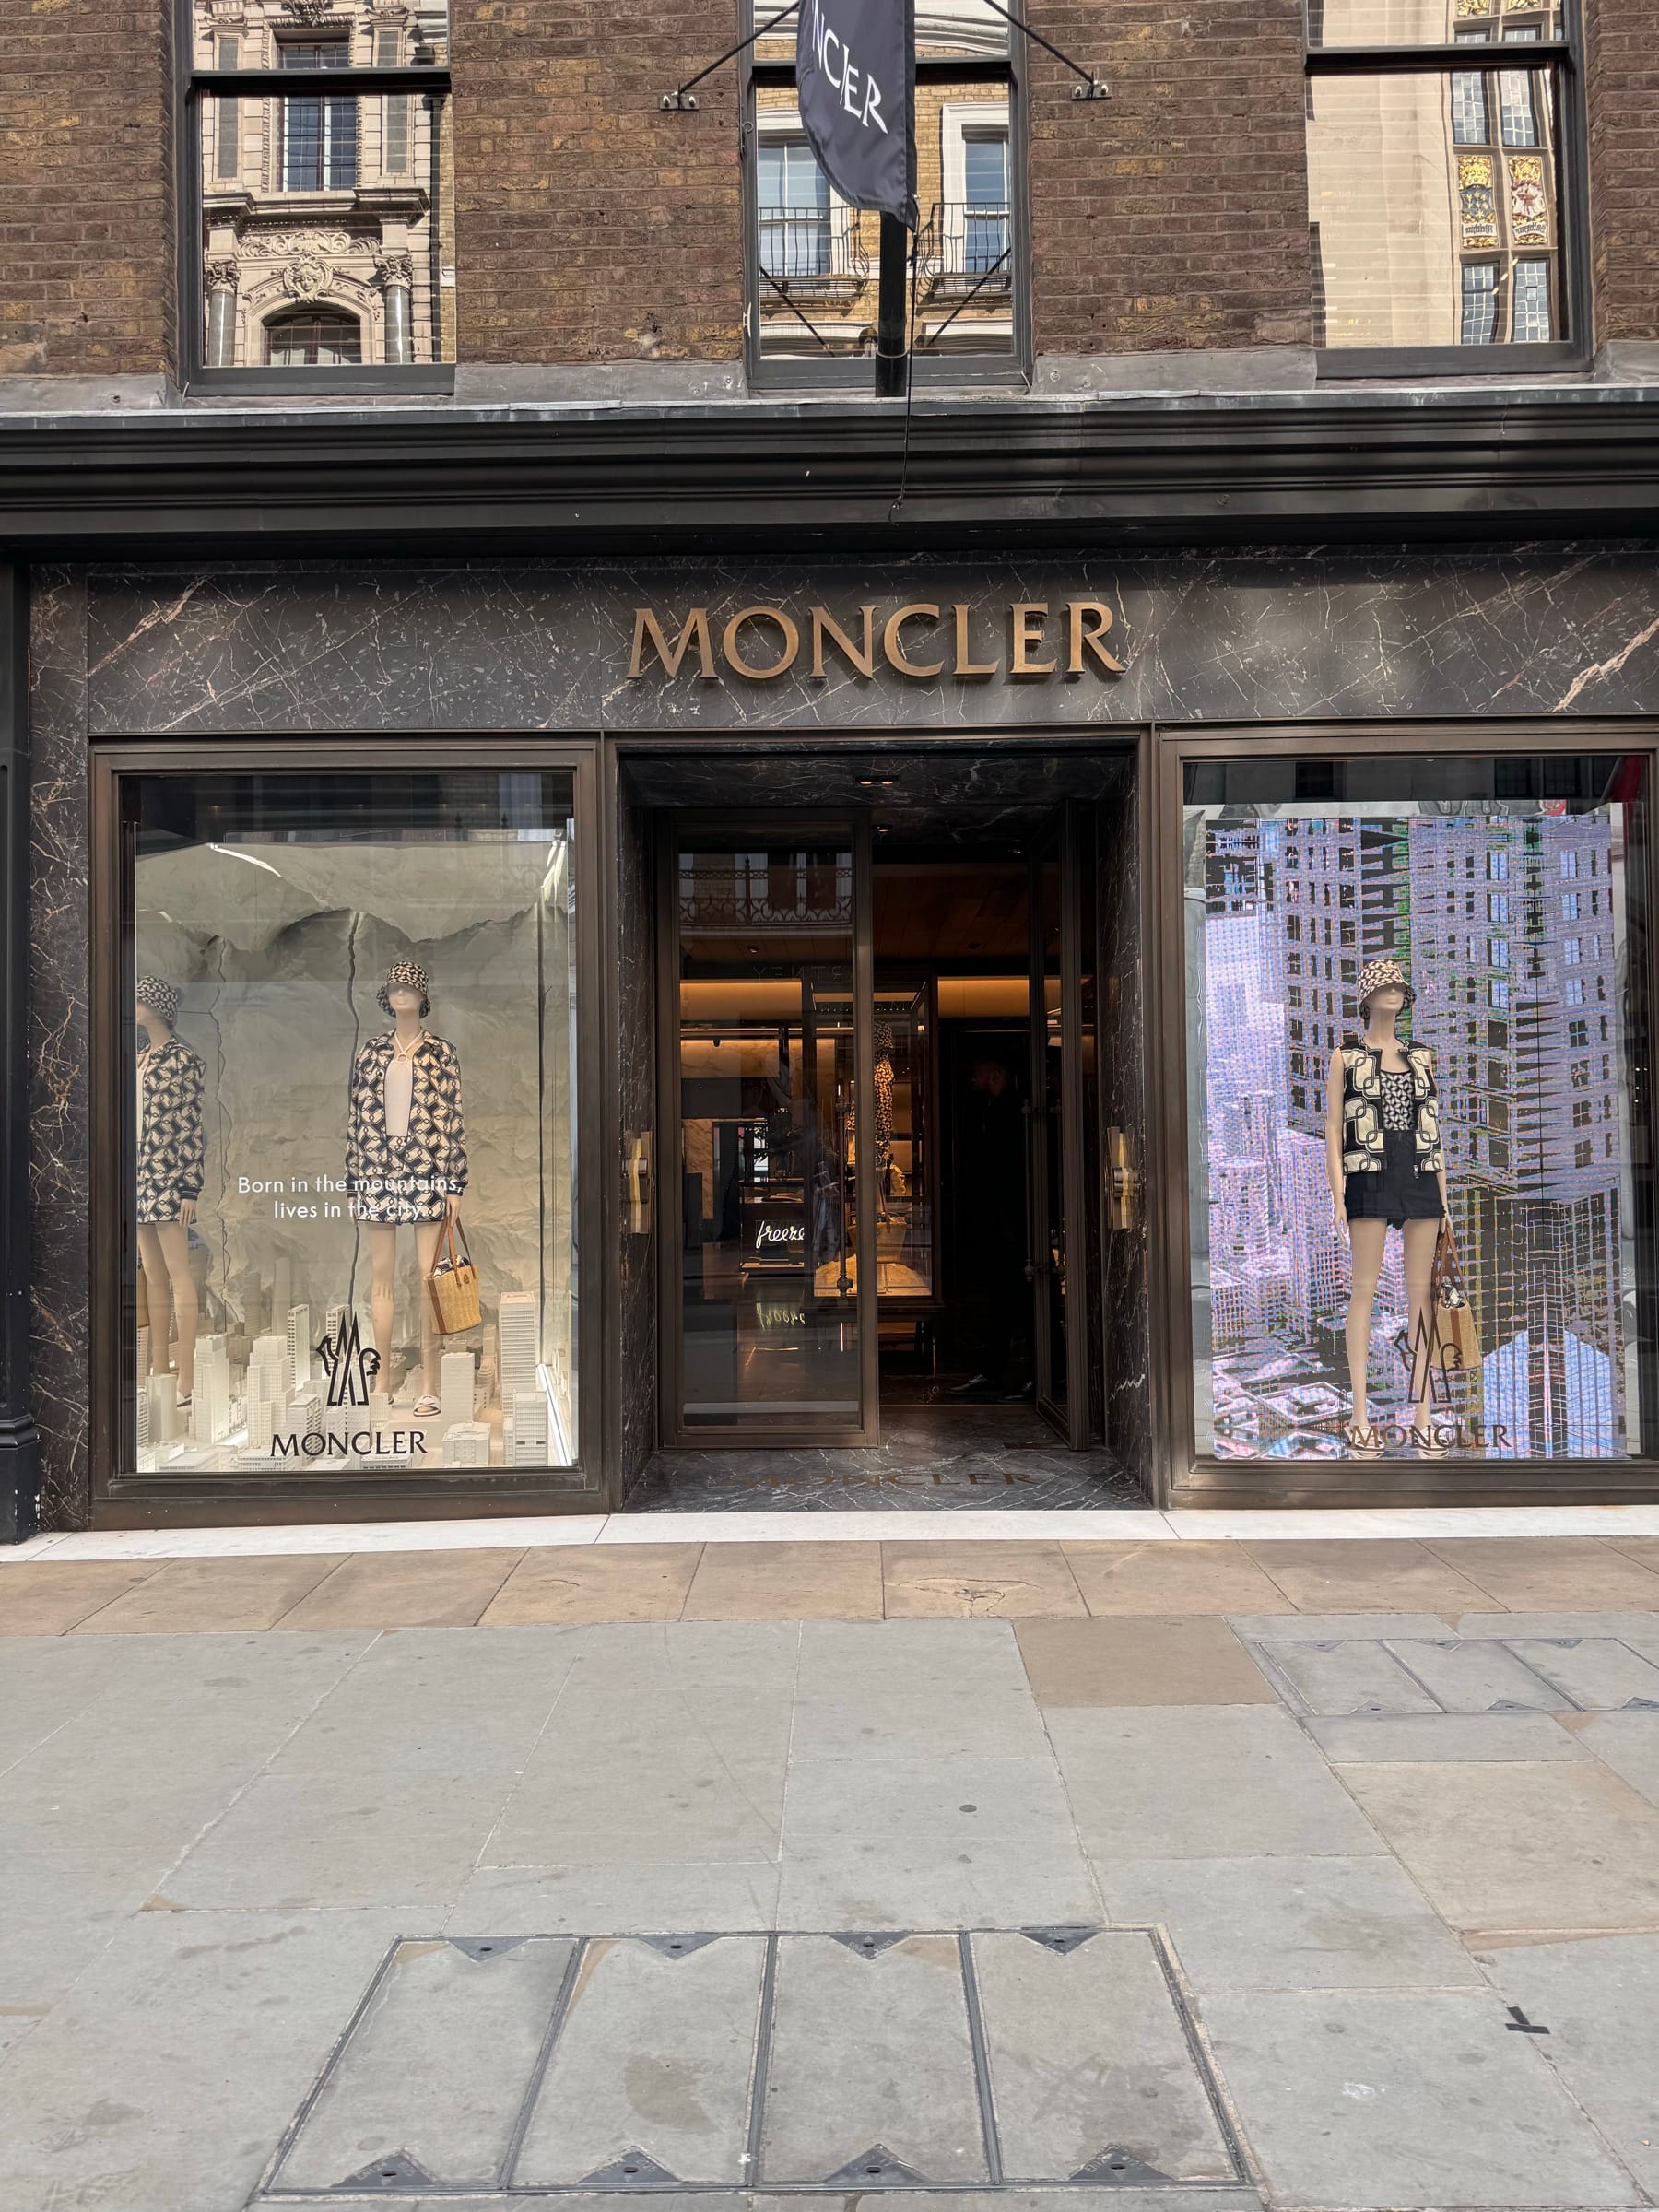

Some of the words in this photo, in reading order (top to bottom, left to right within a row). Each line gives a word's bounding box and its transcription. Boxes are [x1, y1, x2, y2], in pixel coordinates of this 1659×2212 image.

[627, 602, 1126, 680] MONCLER
[237, 1176, 284, 1193] Born
[291, 1176, 309, 1193] in
[315, 1174, 347, 1192] the
[354, 1175, 464, 1194] mountains,
[274, 1200, 318, 1218] lives
[324, 1201, 341, 1217] in
[347, 1199, 379, 1217] the
[270, 1430, 429, 1457] MONCLER
[1349, 1424, 1512, 1449] MONCLER
